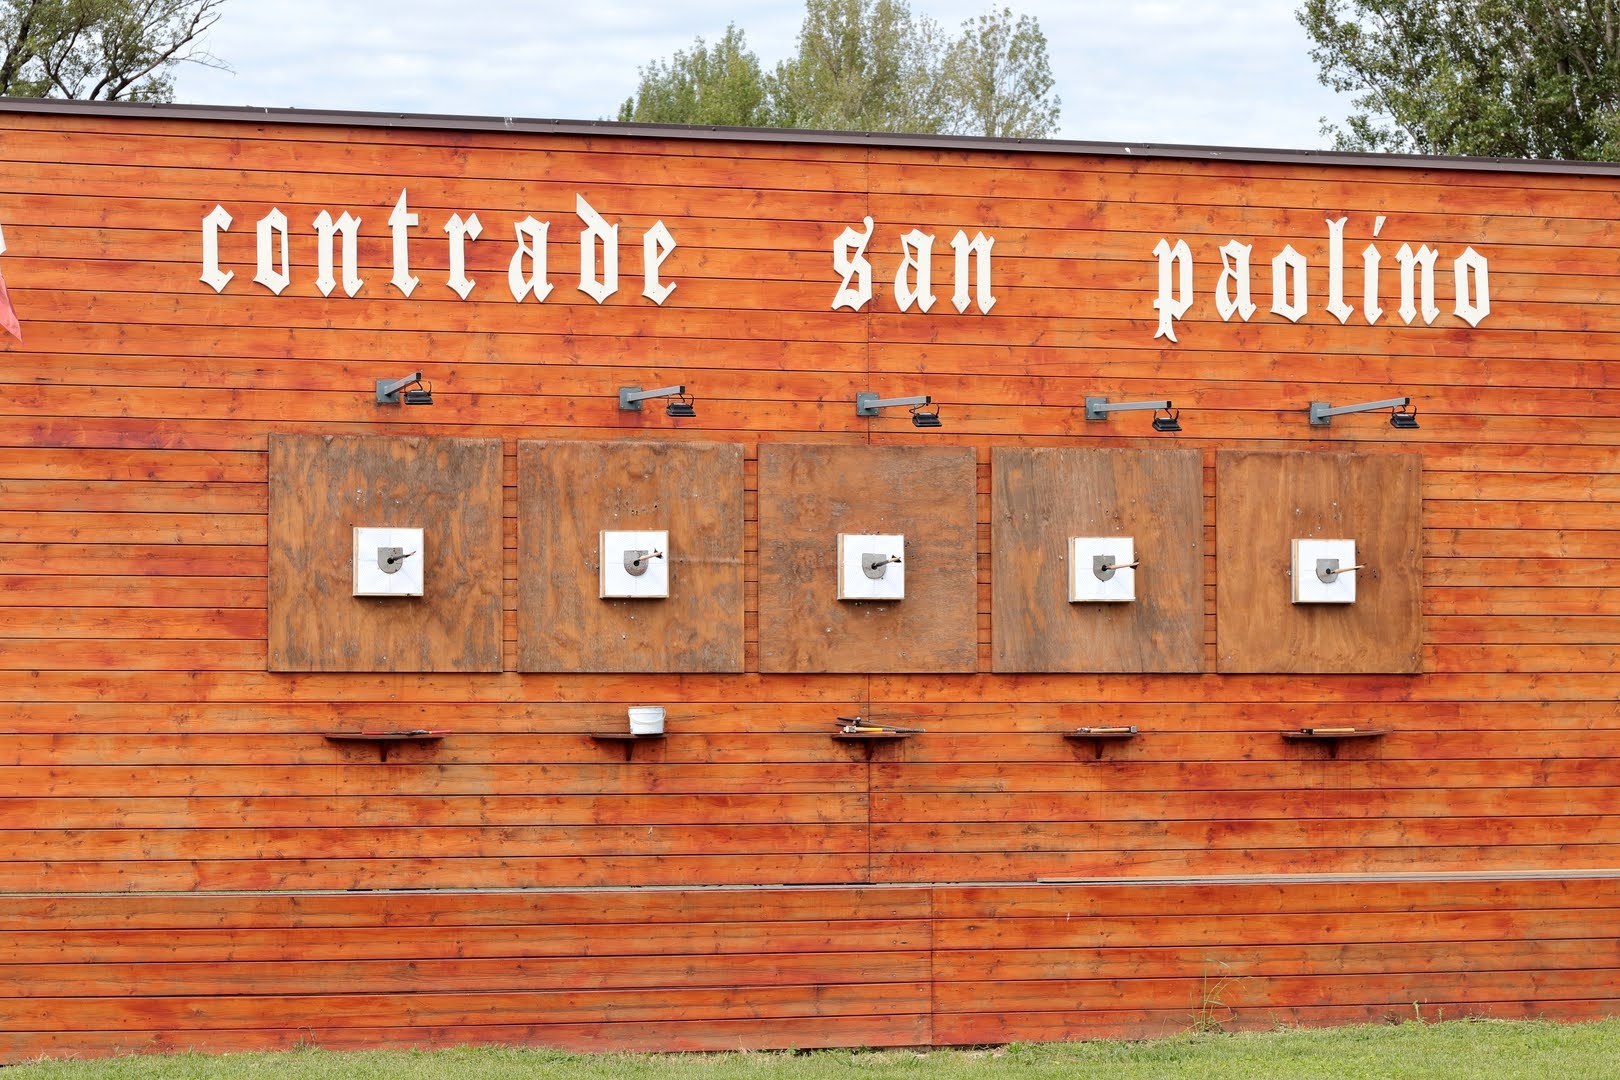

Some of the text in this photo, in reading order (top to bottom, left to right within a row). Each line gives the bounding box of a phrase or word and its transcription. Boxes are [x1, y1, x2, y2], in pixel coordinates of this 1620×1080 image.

[199, 187, 1492, 343] contrade san paolino
